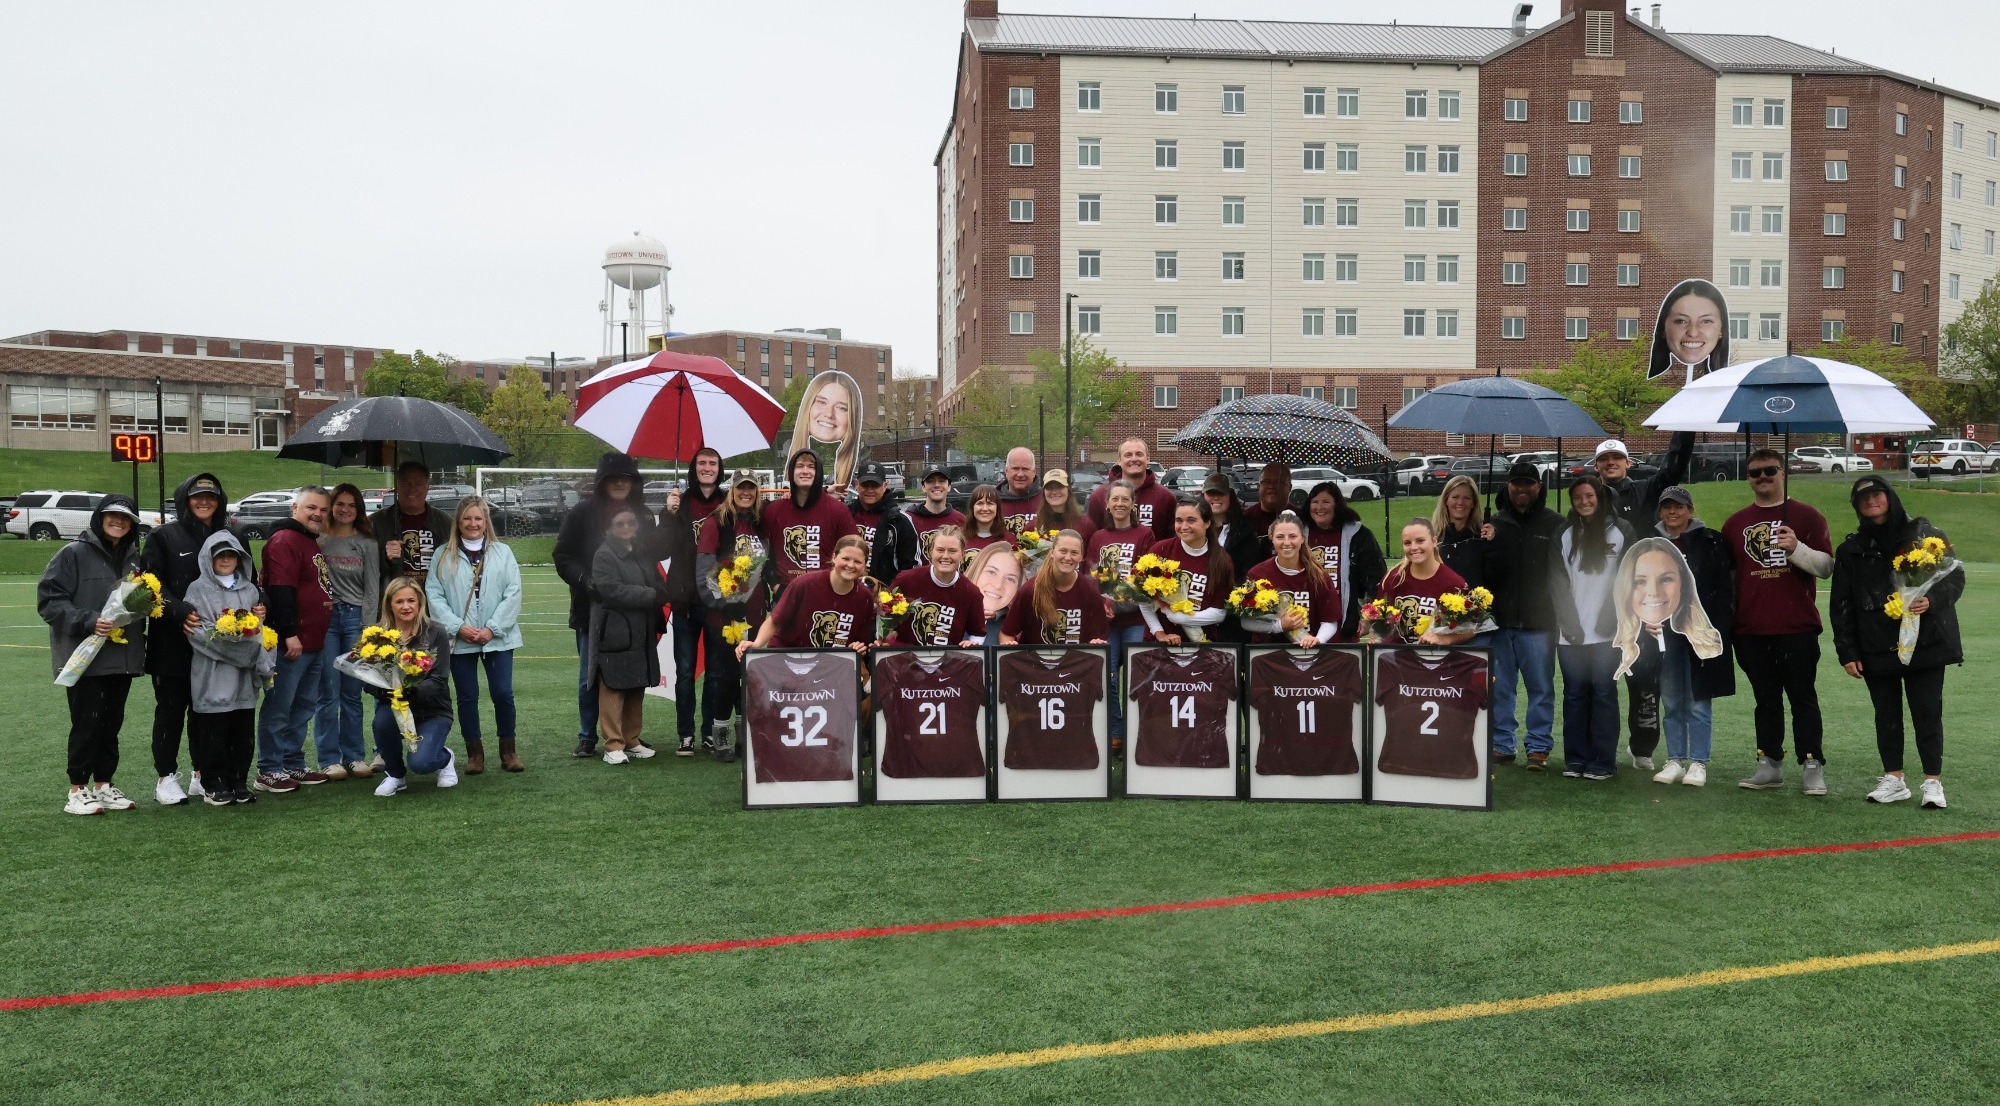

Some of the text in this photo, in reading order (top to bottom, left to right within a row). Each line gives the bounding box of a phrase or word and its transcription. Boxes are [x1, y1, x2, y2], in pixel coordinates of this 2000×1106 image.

[116, 436, 150, 460] 90
[1139, 504, 1153, 527] SEN
[769, 689, 836, 702] KUTZTOWN
[901, 687, 960, 699] KUTZTOWN
[1021, 683, 1081, 695] KUTZTOWN
[1152, 681, 1212, 692] KUTZTOWN
[1273, 685, 1336, 697] KUTZTOWN
[1399, 684, 1464, 698] KUTZTOWN
[919, 702, 947, 734] 21
[1039, 698, 1065, 730] 16
[1170, 696, 1196, 728] 14
[1297, 701, 1316, 733] 11
[1420, 701, 1440, 735] 2
[780, 706, 828, 746] 32
